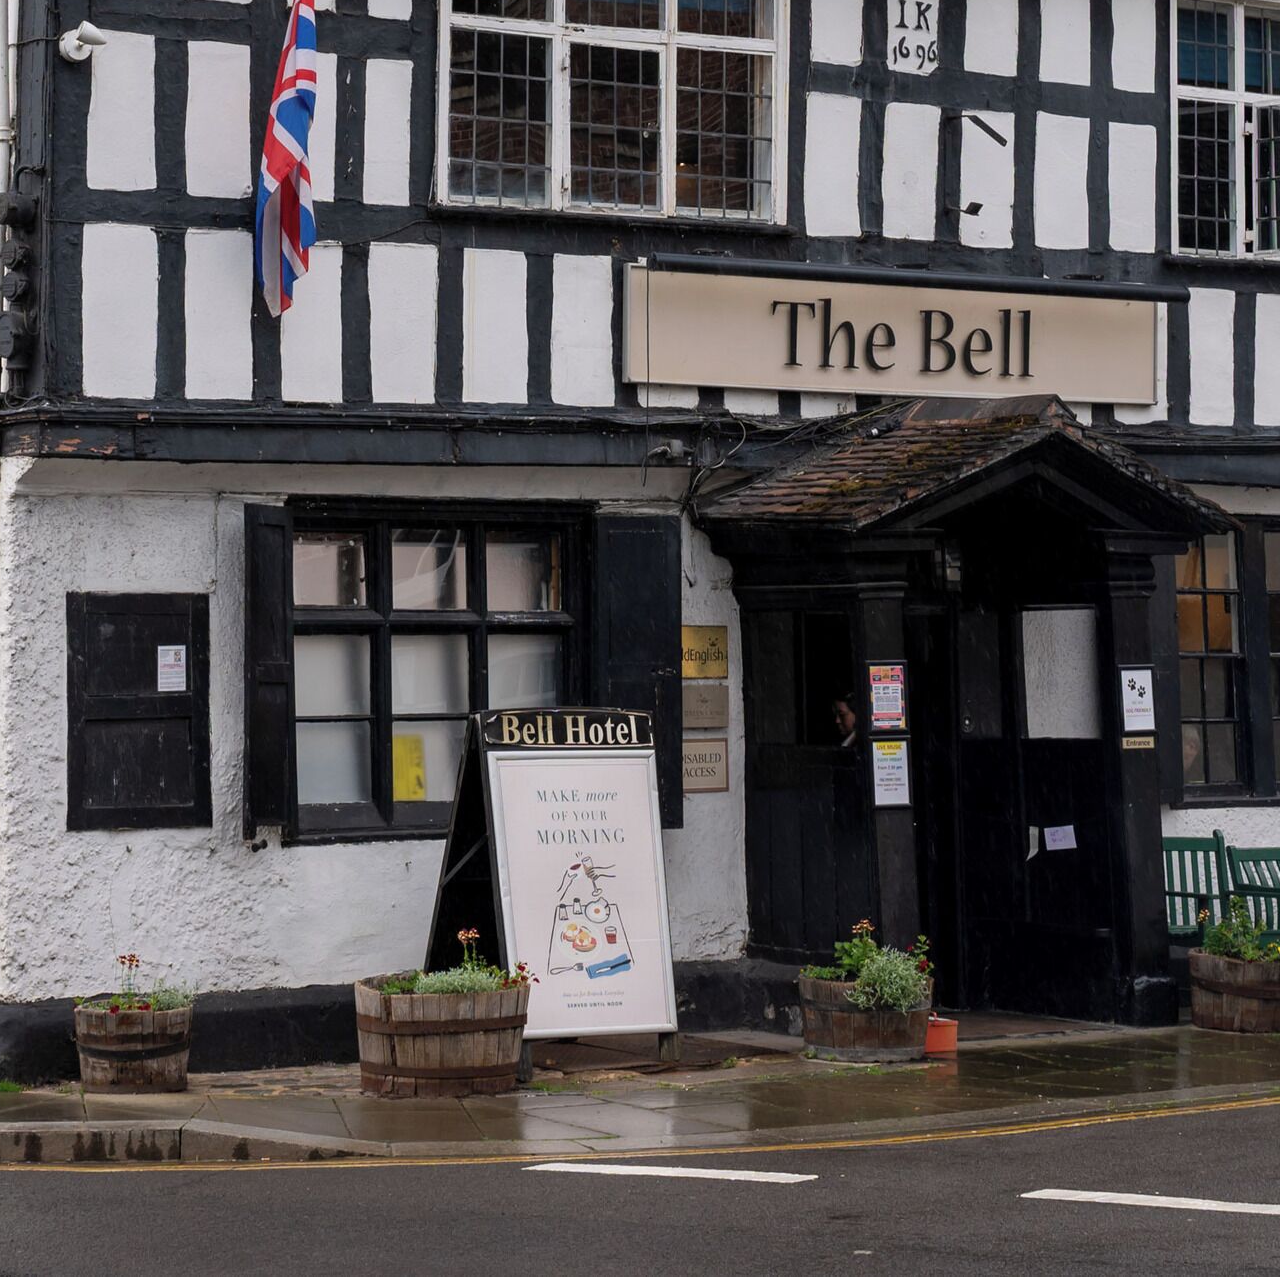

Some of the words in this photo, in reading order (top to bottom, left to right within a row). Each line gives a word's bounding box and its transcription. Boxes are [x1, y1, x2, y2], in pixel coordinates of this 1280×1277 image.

[892, 36, 937, 70] 1696
[771, 298, 896, 371] The
[919, 308, 1034, 378] Bell
[501, 714, 555, 745] Bell
[564, 714, 639, 745] Hotel
[682, 752, 722, 764] ISABLED
[683, 766, 717, 778] ACCESS
[536, 789, 580, 803] MAKE
[586, 791, 618, 802] more
[551, 810, 568, 821] OF
[572, 810, 608, 821] YOUR
[537, 828, 625, 845] MORNING
